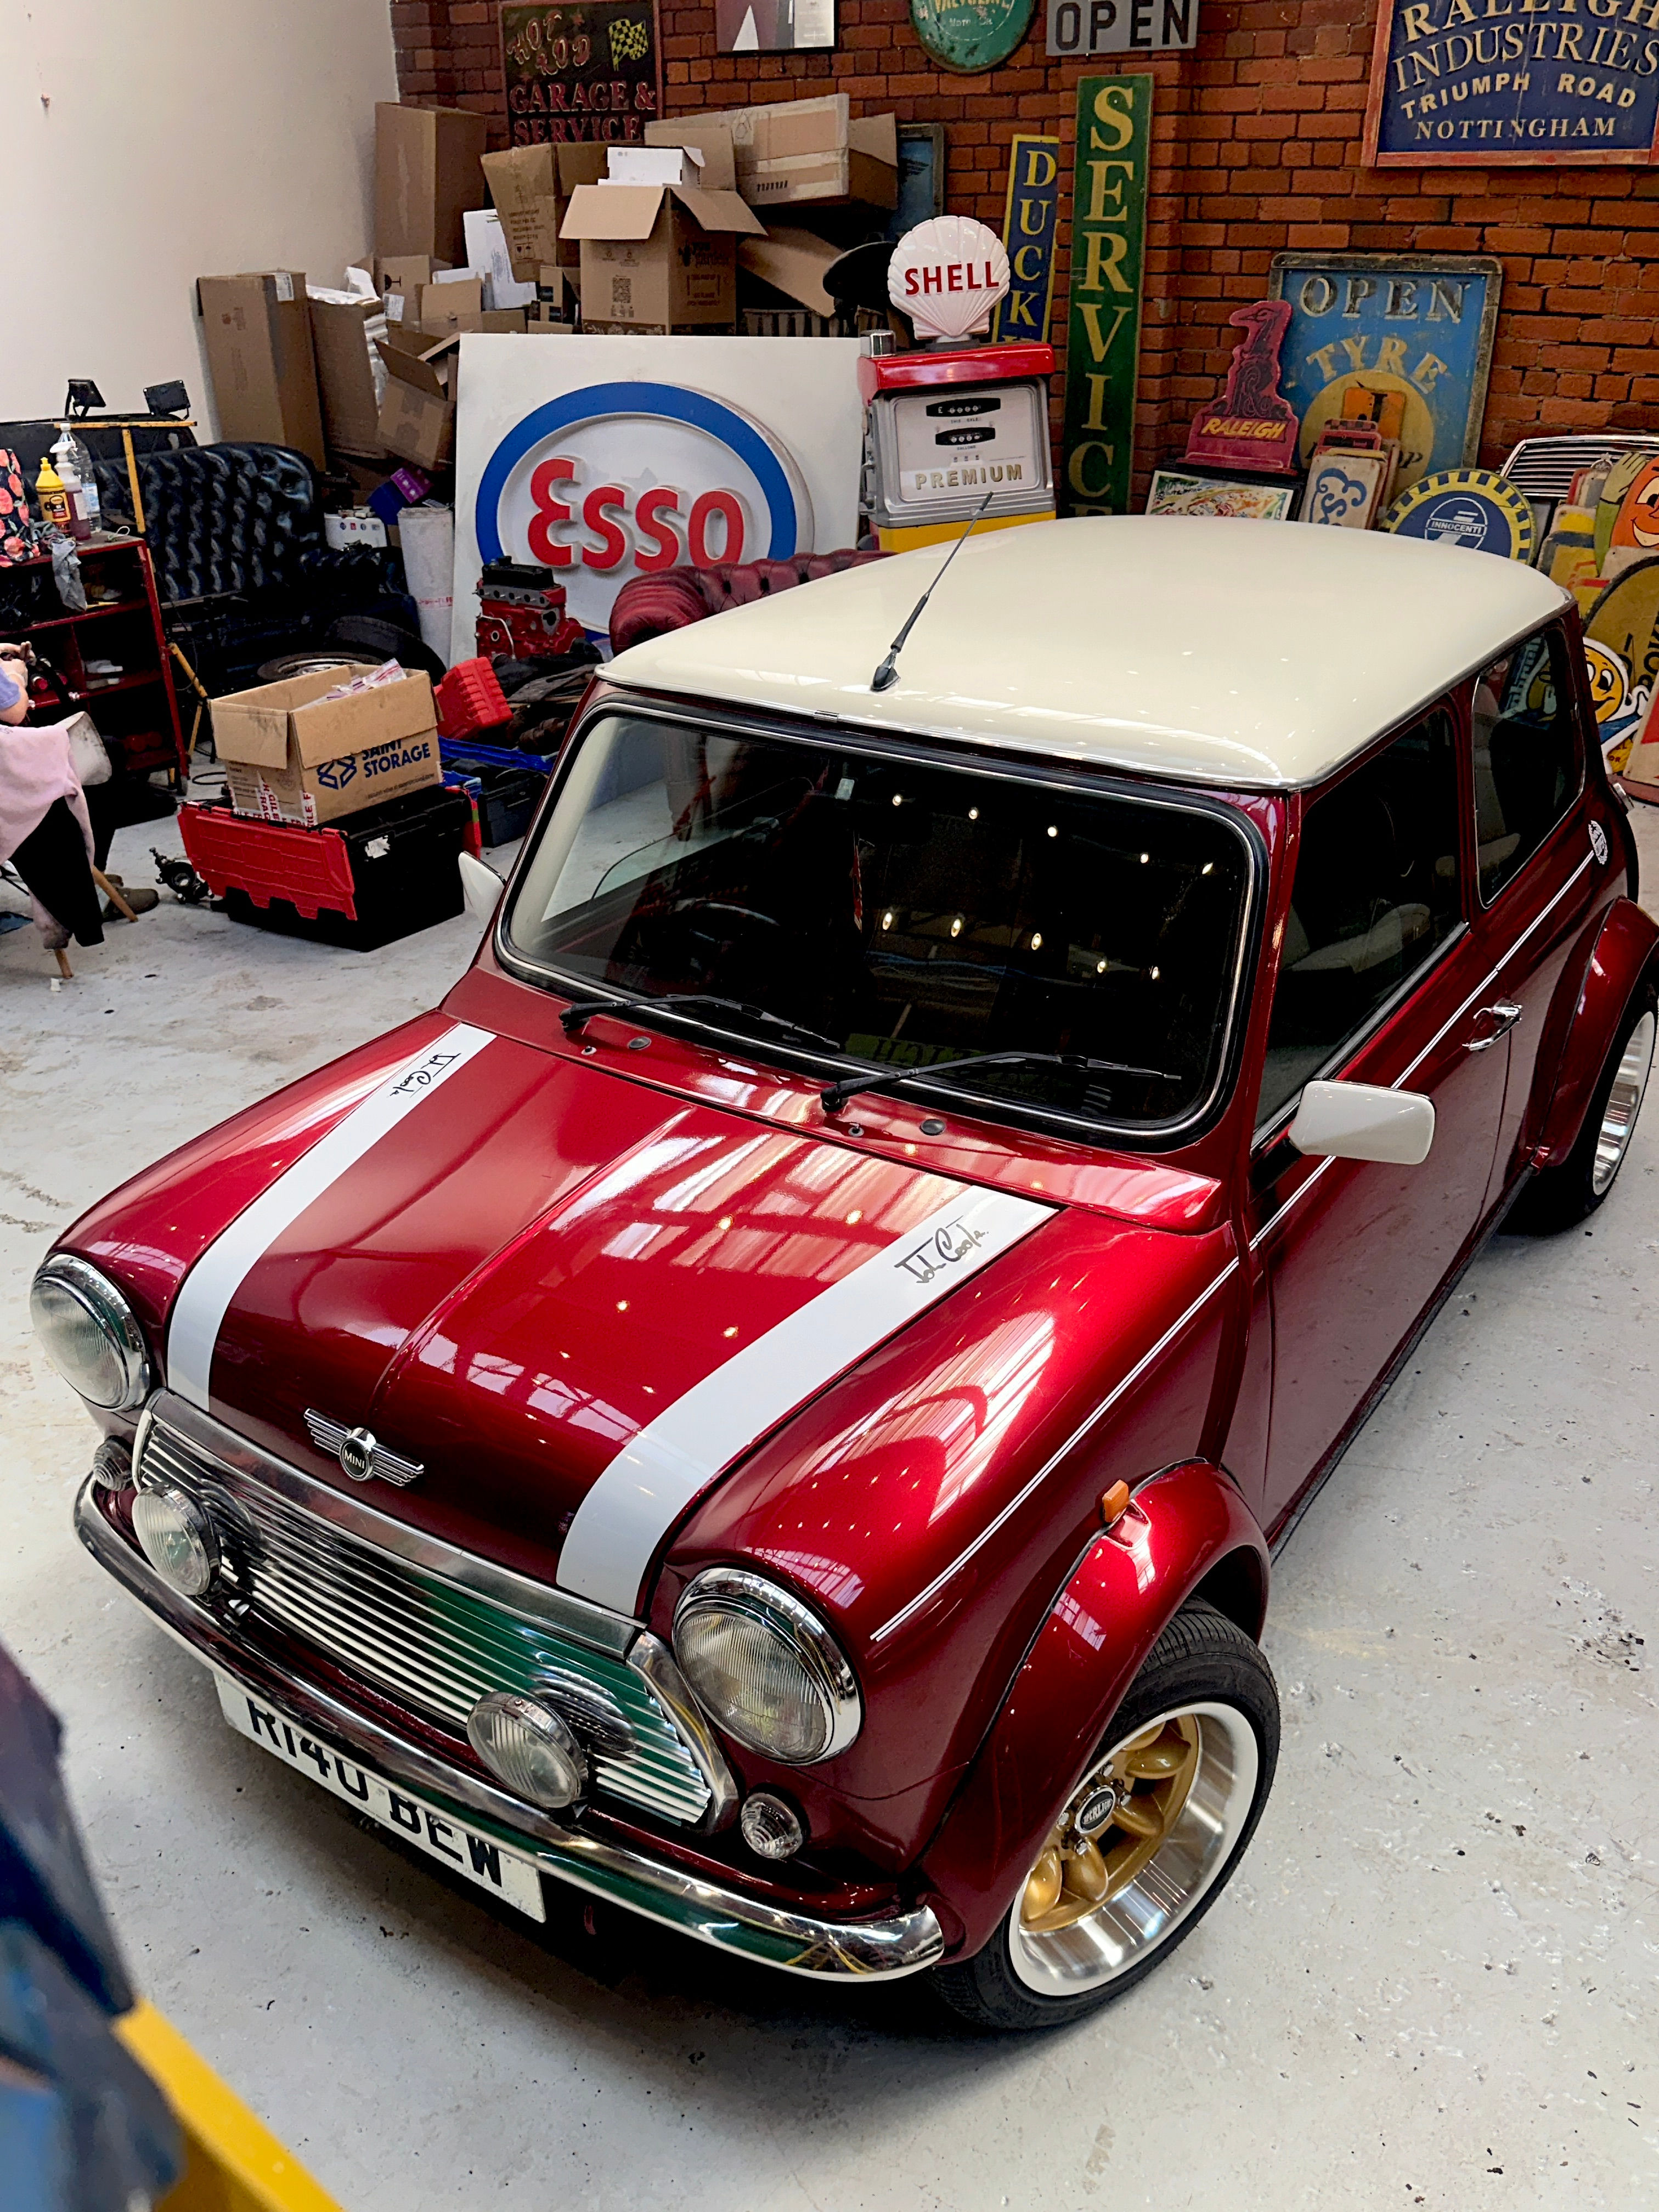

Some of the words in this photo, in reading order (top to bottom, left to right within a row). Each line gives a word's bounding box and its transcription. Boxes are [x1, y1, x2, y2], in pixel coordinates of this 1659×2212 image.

[506, 9, 562, 65] HOT
[1056, 0, 1189, 51] OPEN
[535, 35, 590, 76] ROD
[1392, 22, 1659, 92] INDUSTRIES
[509, 80, 630, 114] GARAGE
[634, 81, 656, 110] &
[1401, 72, 1530, 119] TRIUMPH
[1558, 74, 1637, 109] ROAD
[514, 116, 641, 146] SERVICE
[1414, 117, 1616, 140] NOTTINGHAM
[1001, 150, 1056, 342] DUCK
[905, 261, 1000, 296] SHELL
[1068, 86, 1135, 517] SERVIC
[1300, 275, 1471, 324] OPEN
[1305, 334, 1448, 395] TYRE
[1200, 417, 1287, 439] RALEIGH
[916, 464, 1022, 490] PREMIUM
[1431, 521, 1482, 534] INNOCENTI
[364, 742, 431, 778] STORAGE
[344, 1449, 365, 1469] MINI
